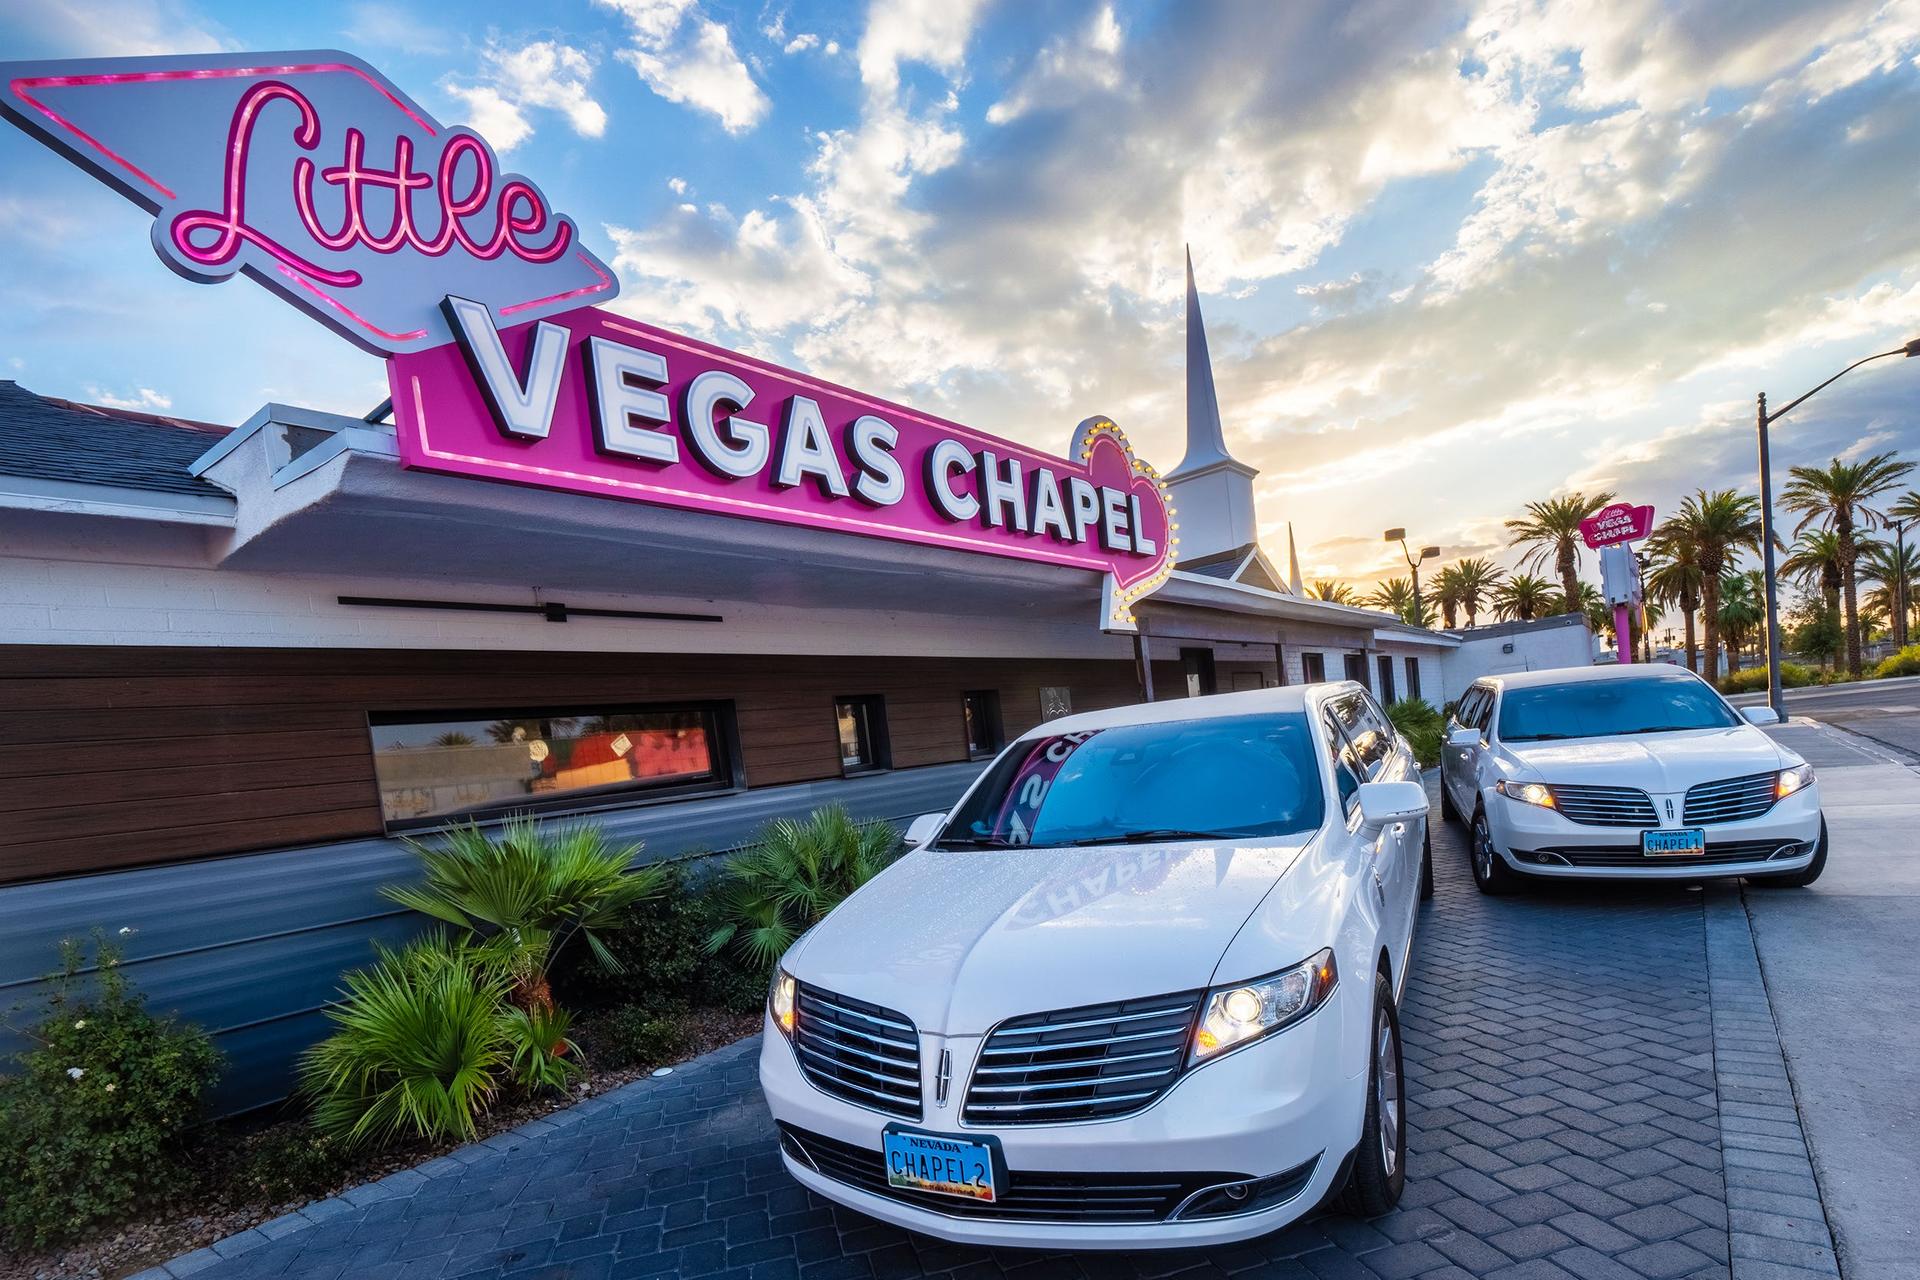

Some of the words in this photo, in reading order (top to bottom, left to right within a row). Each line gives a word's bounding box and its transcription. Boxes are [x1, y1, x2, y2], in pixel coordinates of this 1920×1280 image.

[170, 80, 573, 287] Little
[441, 294, 905, 507] VEGAS
[923, 437, 1157, 556] CHAPEL
[909, 1138, 961, 1153] NEVADA
